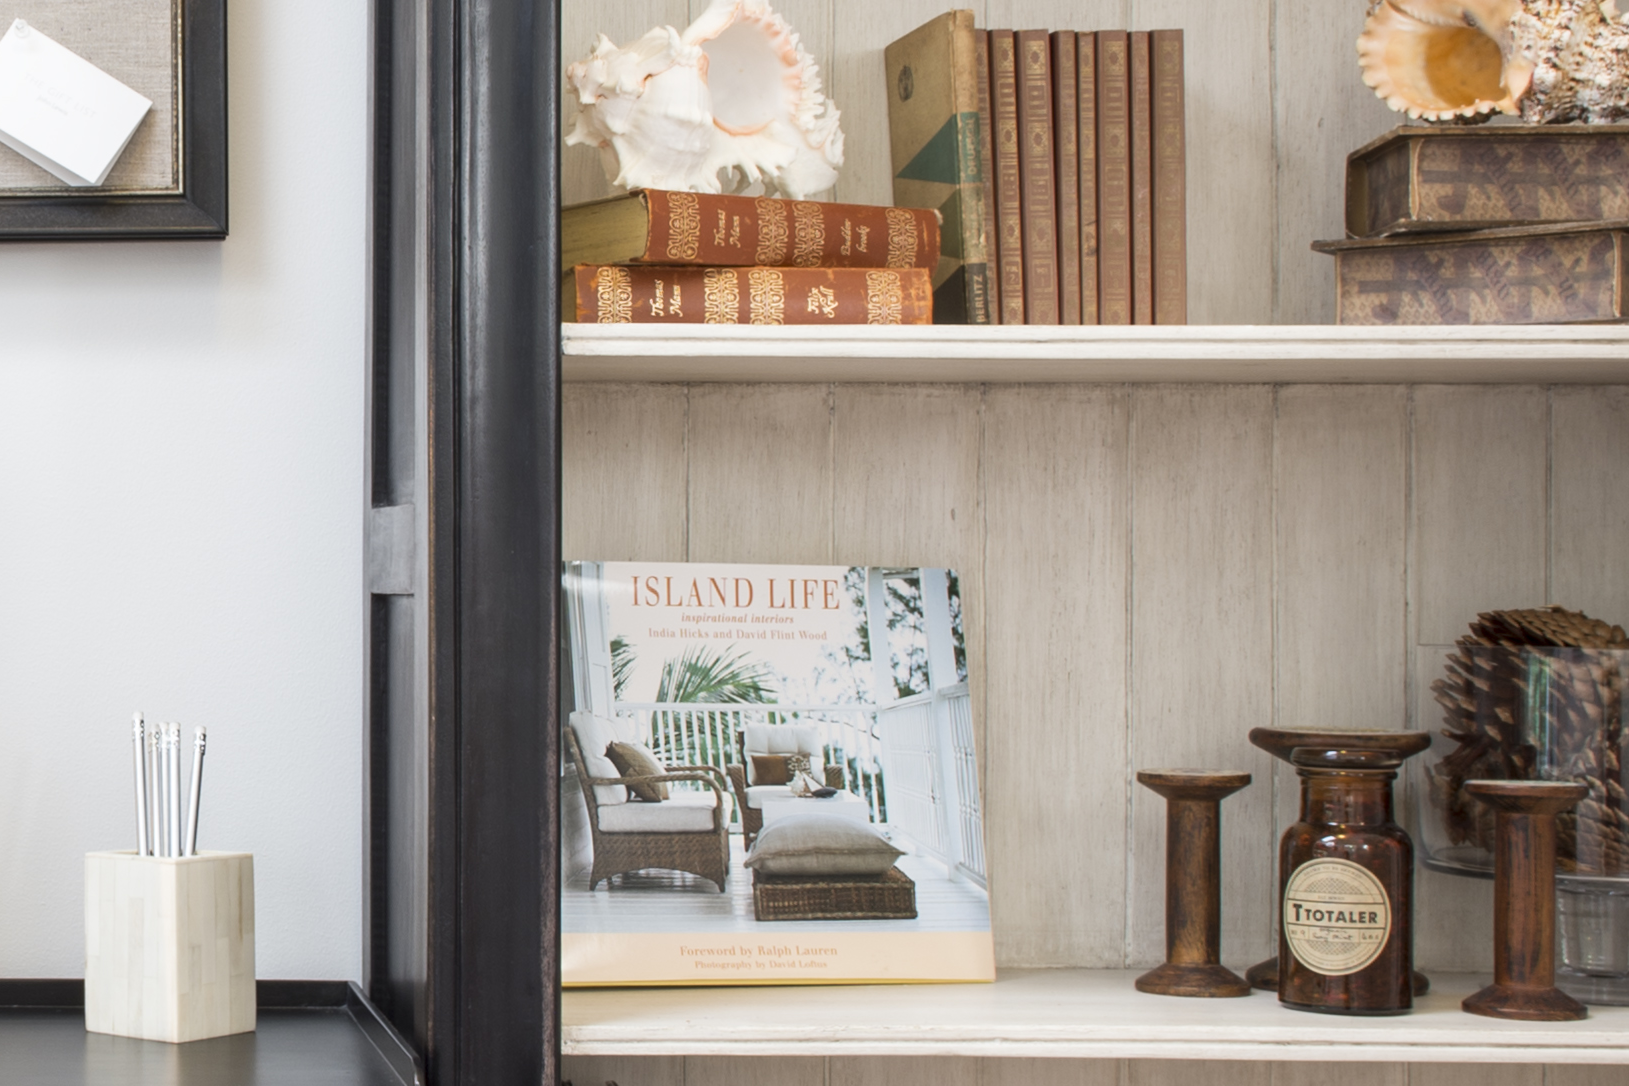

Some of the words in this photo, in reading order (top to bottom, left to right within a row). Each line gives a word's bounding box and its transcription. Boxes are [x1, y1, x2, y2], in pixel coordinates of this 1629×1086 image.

[714, 209, 726, 247] Thomas
[730, 215, 741, 248] Mann
[651, 279, 664, 317] Thomas
[670, 285, 683, 318] Mann
[822, 286, 839, 319] Krull
[976, 274, 985, 323] BERLITZ
[631, 576, 754, 609] ISLAND
[767, 578, 841, 610] LIFE
[648, 627, 676, 638] India
[679, 628, 709, 639] Hicks
[713, 628, 732, 639] and
[736, 629, 767, 640] David
[770, 629, 795, 640] Flint
[798, 630, 828, 640] Wood
[681, 612, 748, 624] inspirational
[751, 614, 794, 624] interiors
[1292, 903, 1378, 924] TTOTALER
[680, 946, 736, 957] Foreword
[739, 946, 753, 958] by
[758, 945, 792, 958] Ralph
[796, 945, 838, 957] Lauren
[694, 960, 752, 970] Photography
[755, 960, 767, 970] by
[769, 960, 796, 969] David
[799, 960, 828, 969] Loftus
